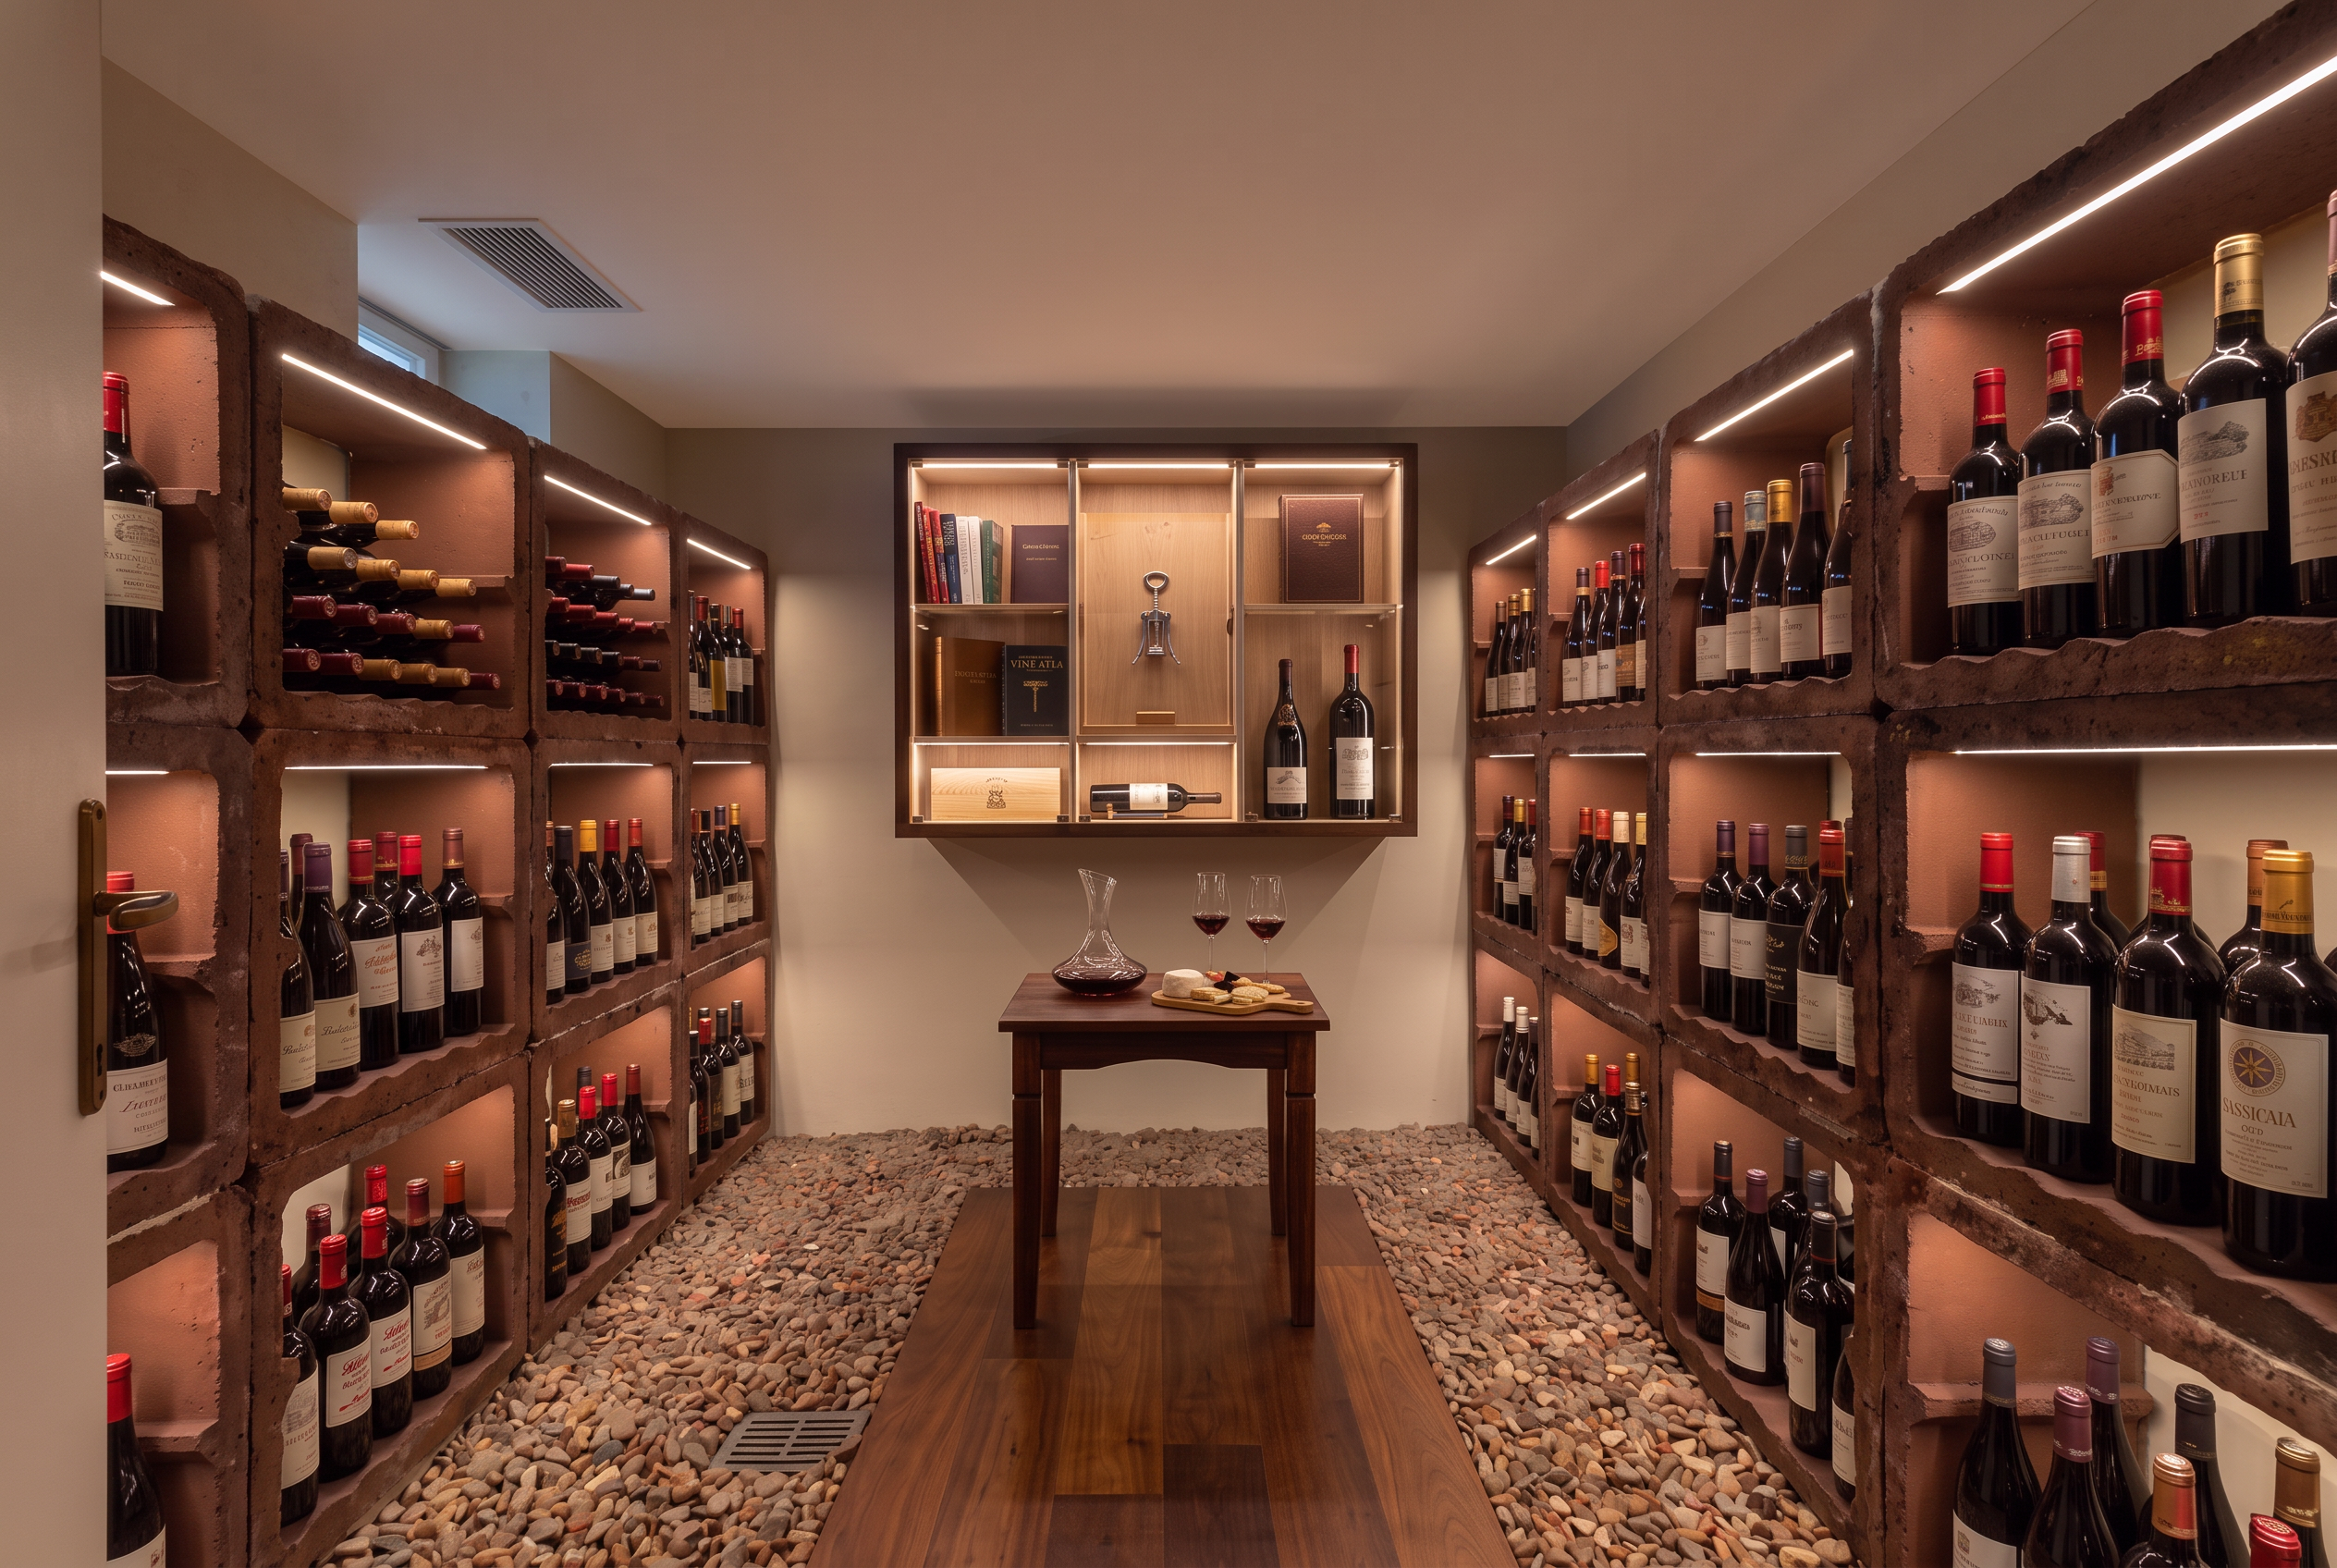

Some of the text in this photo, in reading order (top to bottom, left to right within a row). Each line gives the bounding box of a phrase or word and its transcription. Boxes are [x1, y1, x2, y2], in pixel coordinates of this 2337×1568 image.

[1010, 659, 1064, 668] VINE ATLA
[2222, 1096, 2297, 1129] SASSICAIA
